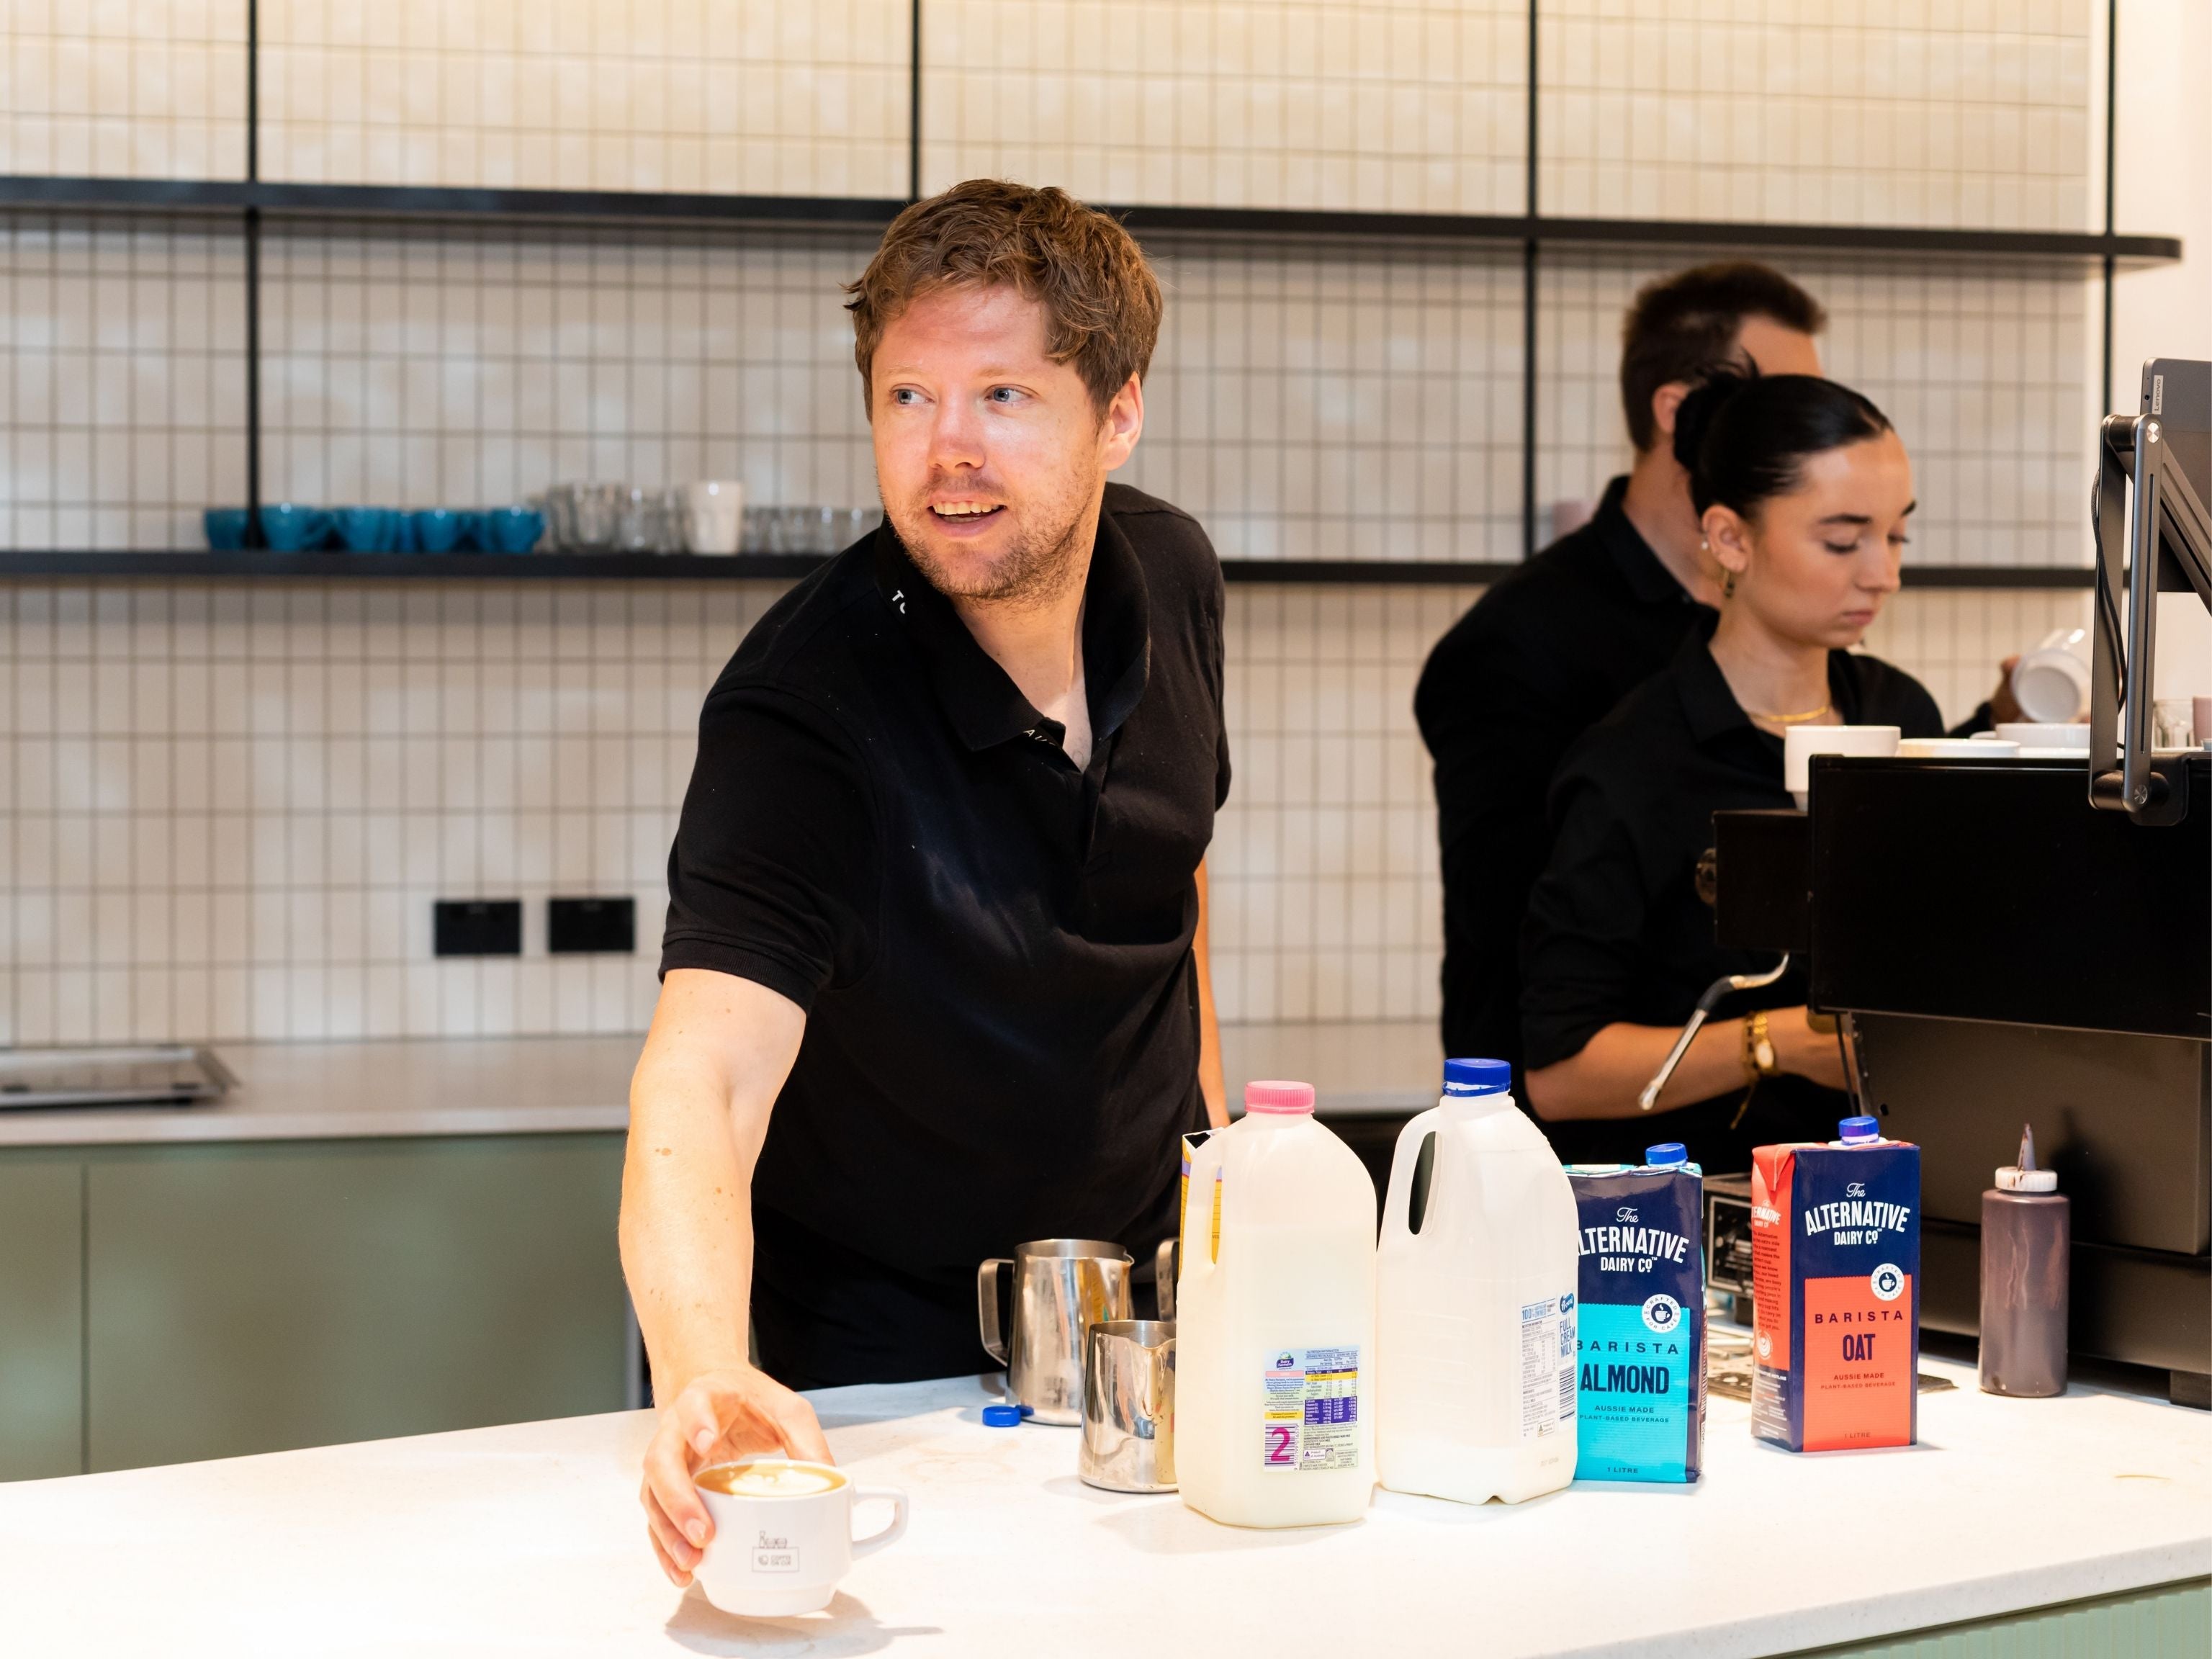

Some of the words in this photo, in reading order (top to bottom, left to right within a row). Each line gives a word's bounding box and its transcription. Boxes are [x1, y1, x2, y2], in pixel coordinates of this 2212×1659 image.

[1846, 1182, 1866, 1197] The
[1616, 1207, 1639, 1223] The
[1804, 1201, 1910, 1236] ALTERNATIVE
[1834, 1231, 1863, 1245] DAIRY
[1601, 1257, 1635, 1272] DAIRY
[1646, 1296, 1678, 1310] CRAFTED
[1815, 1310, 1903, 1324] BARISTA
[1560, 1317, 1571, 1334] FULL
[1560, 1326, 1575, 1346] CREAM
[1560, 1341, 1573, 1358] MILK
[1578, 1341, 1678, 1354] BARISTA
[1843, 1334, 1876, 1362] OAT
[1580, 1363, 1670, 1394] ALMOND
[1270, 1427, 1290, 1462] 2
